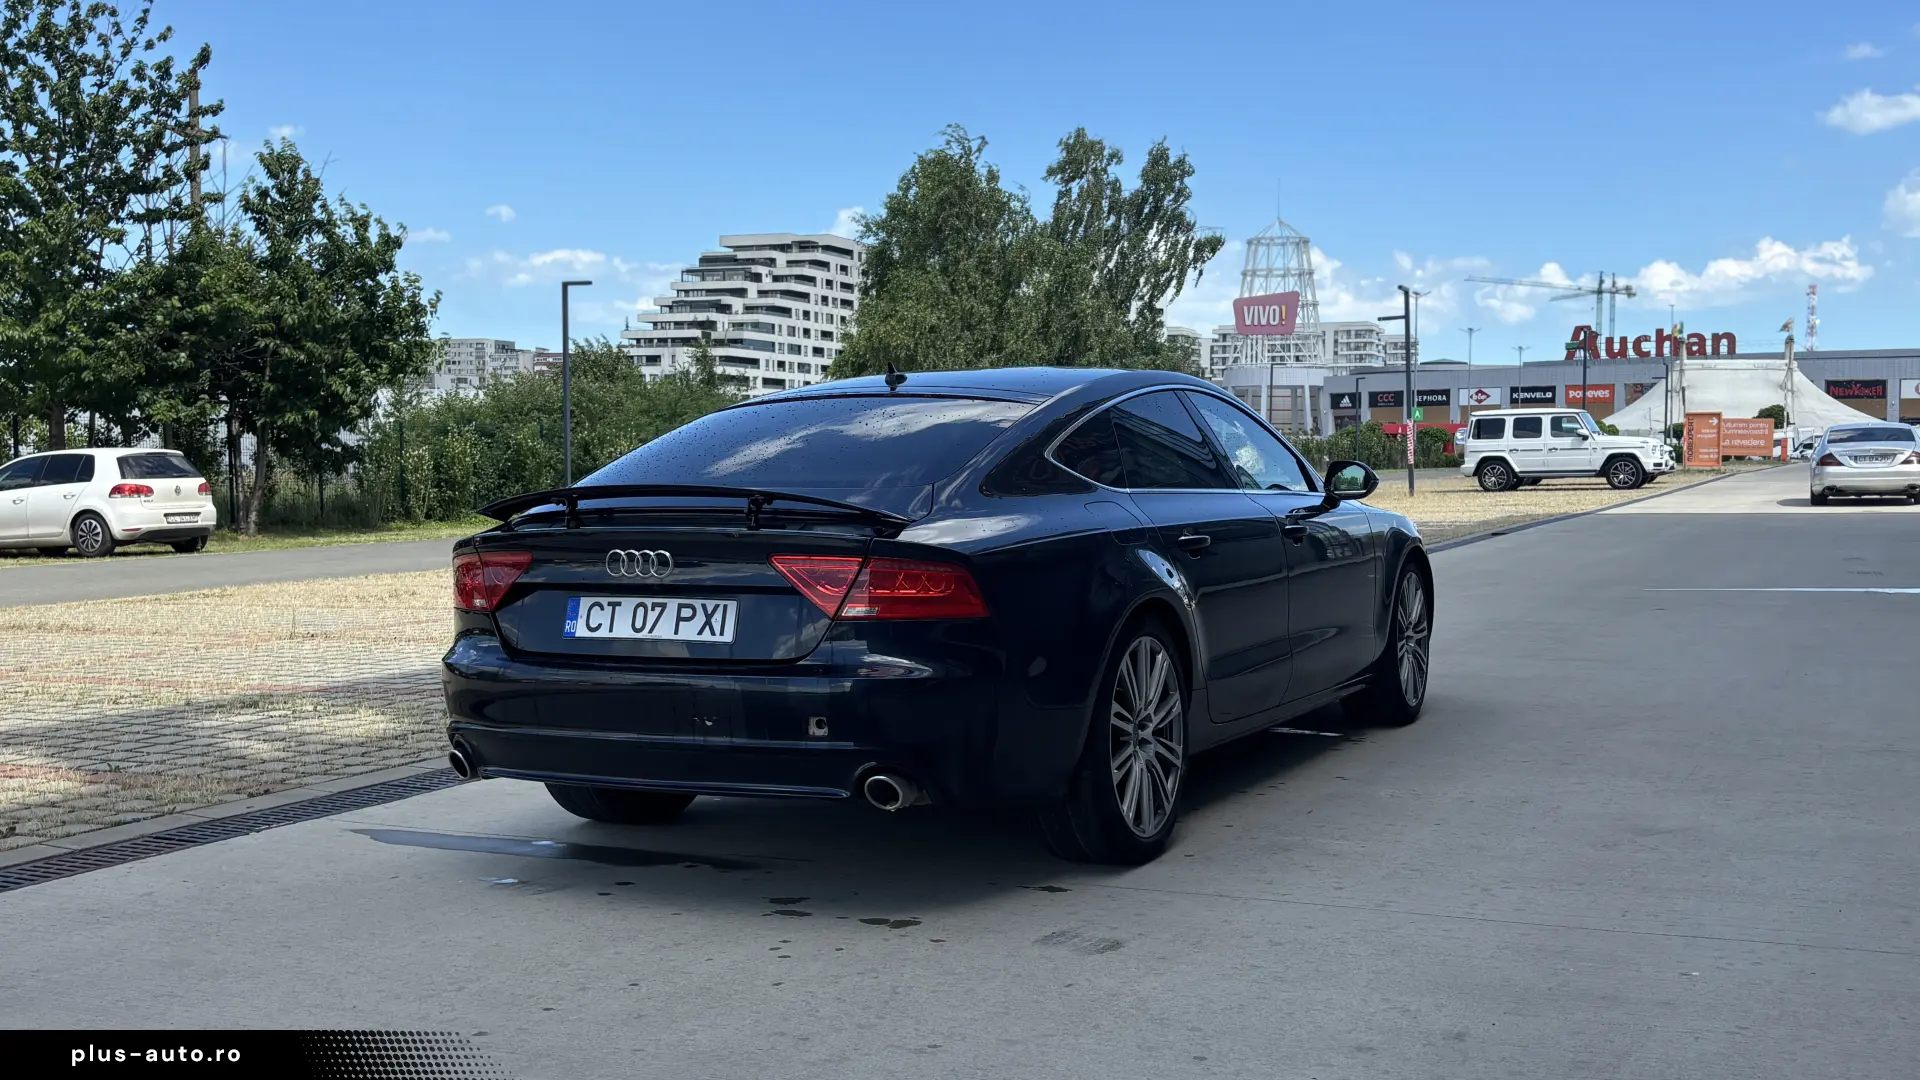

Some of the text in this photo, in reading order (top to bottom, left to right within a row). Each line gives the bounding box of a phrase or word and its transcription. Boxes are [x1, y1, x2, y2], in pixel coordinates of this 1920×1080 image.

[1243, 304, 1286, 326] VIVO!
[1565, 325, 1737, 361] Auchan
[1377, 393, 1395, 402] CCC
[1415, 394, 1447, 402] SEPHORA
[1512, 391, 1553, 399] KENVELO
[1731, 438, 1765, 446] revedere
[585, 601, 728, 637] CT 07 PXI
[565, 620, 577, 633] RO
